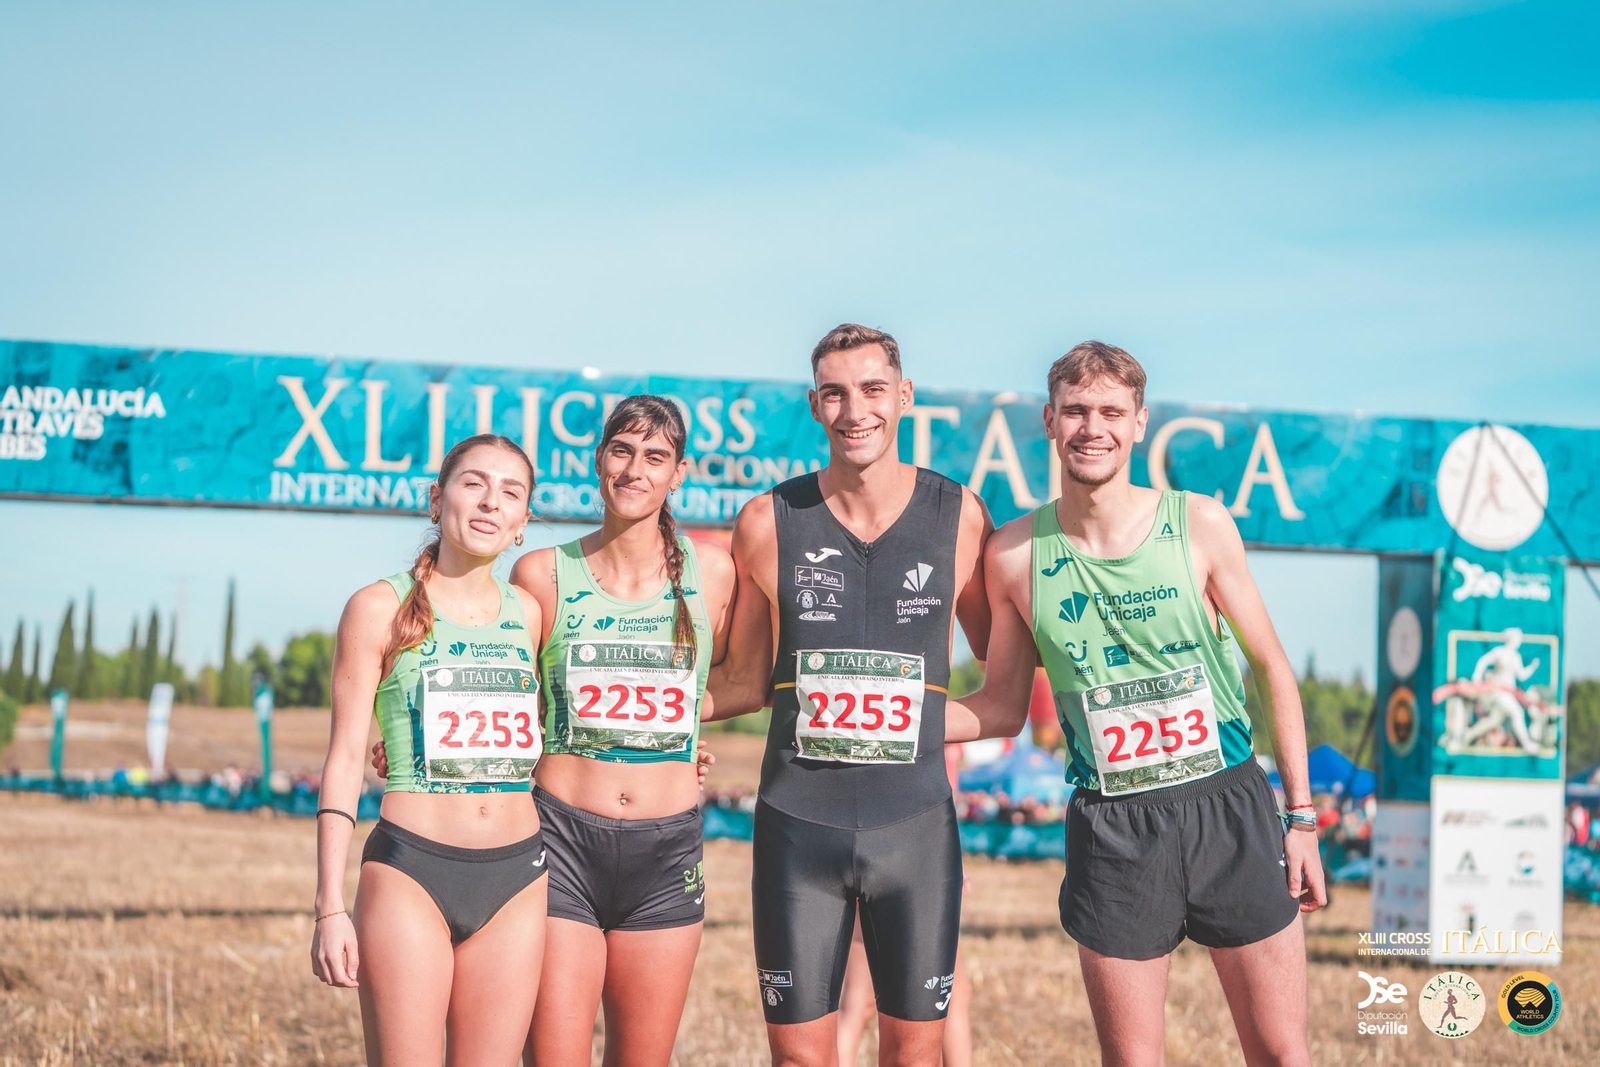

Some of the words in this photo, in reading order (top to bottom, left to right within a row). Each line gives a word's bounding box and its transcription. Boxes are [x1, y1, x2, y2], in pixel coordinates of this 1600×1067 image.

[1, 385, 166, 418] ANDALUCÍA
[550, 390, 757, 454] CSS
[902, 391, 1307, 521] TÁCA
[269, 471, 437, 510] INTERNAT
[897, 597, 941, 607] Fundación
[1094, 585, 1178, 606] Fundación
[619, 615, 672, 625] Fundación
[897, 607, 929, 616] Unicaja
[1098, 603, 1156, 623] Unicaja
[618, 624, 658, 633] Unicaja
[470, 642, 515, 651] Fundación
[471, 650, 508, 659] Unicaja
[605, 645, 664, 660] ITÁLICA
[833, 653, 891, 669] ITÁLICA
[462, 669, 514, 684] ITÁLICA
[1120, 678, 1177, 699] ITÁLICA
[577, 684, 684, 723] 2253
[808, 692, 911, 731] 2253
[438, 710, 534, 749] 2253
[1103, 709, 1208, 763] 2253
